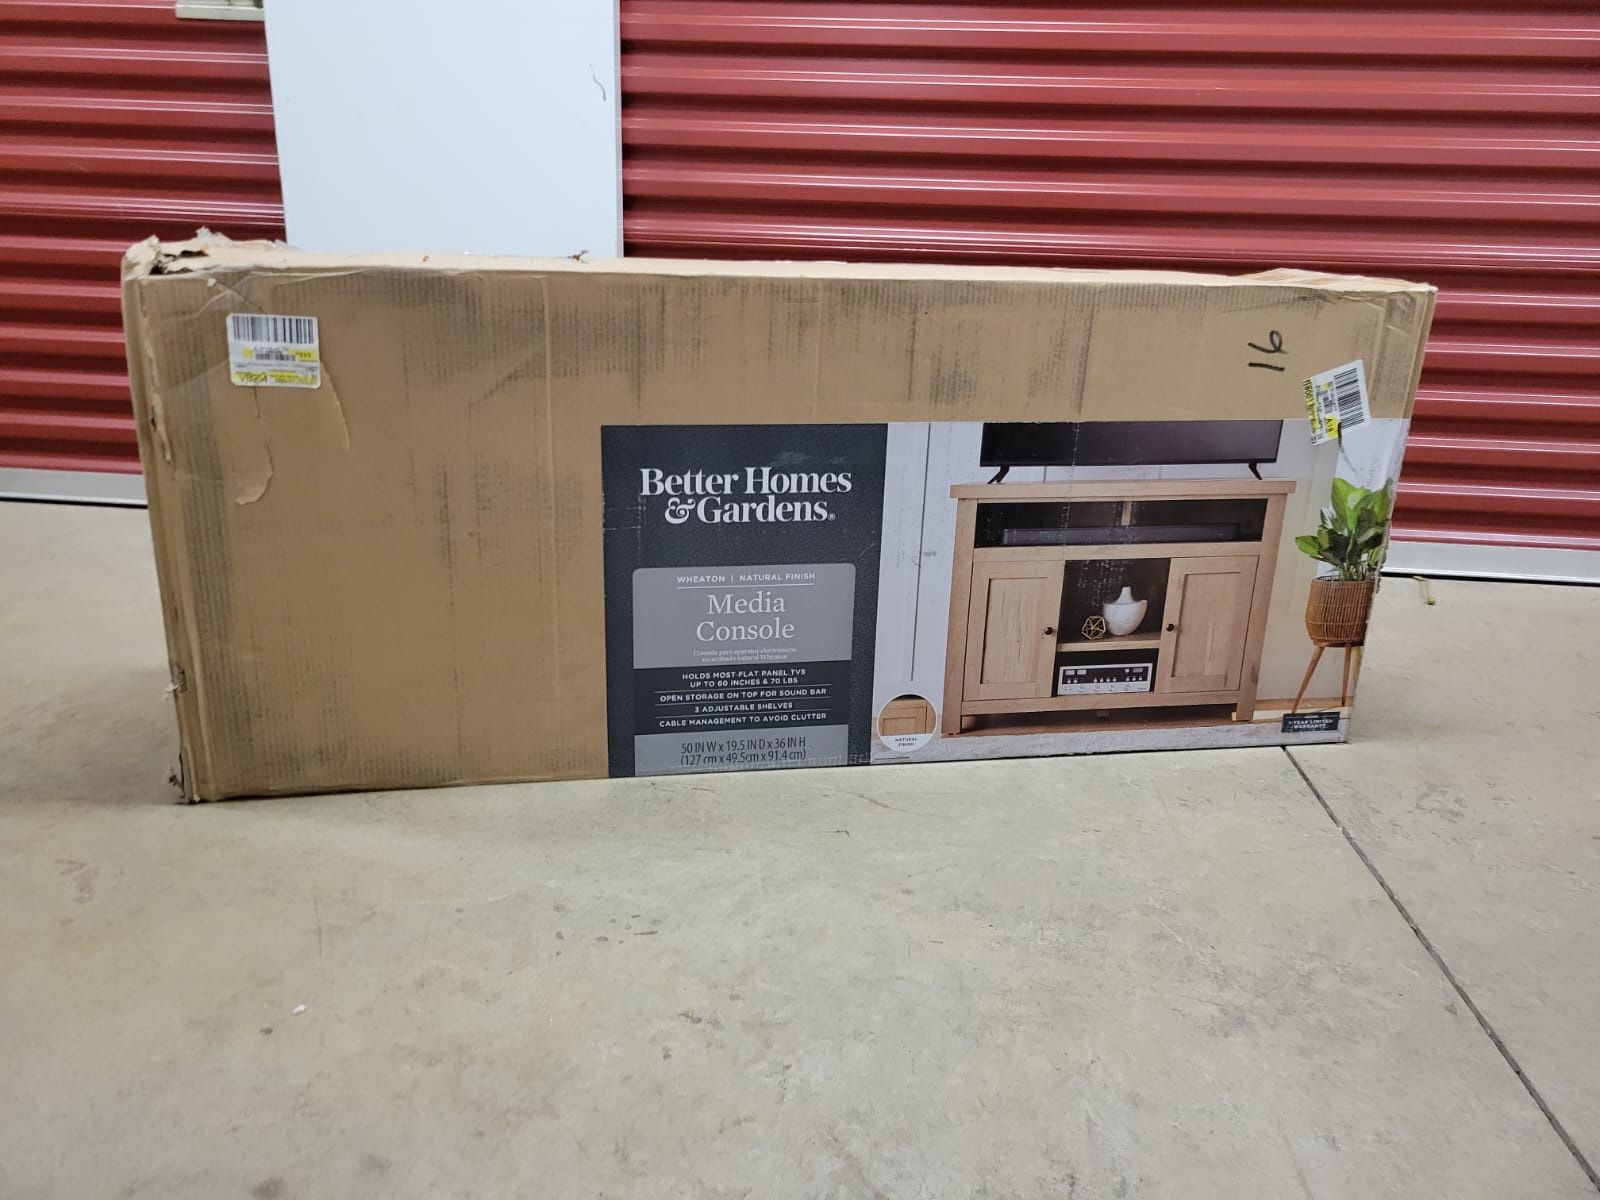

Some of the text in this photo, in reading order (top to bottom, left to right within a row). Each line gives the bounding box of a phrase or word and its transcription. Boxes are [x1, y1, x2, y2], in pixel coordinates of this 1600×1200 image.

[640, 467, 852, 495] Better Homes
[676, 572, 816, 584] WHEATON NATURAL FINISH
[707, 590, 787, 615] Media
[696, 617, 795, 643] Console
[682, 668, 806, 681] HOLDS MOST FLAT PANEL TVS
[730, 679, 761, 687] INCHES
[660, 694, 683, 702] OPEN
[685, 692, 724, 701] STORAGE
[779, 689, 808, 697] SOUND
[702, 703, 755, 713] ADJUSTABLE
[757, 702, 793, 710] SHELVES
[659, 713, 827, 728] CABLE MANAGEMENT TO AVOID CLUTTER
[681, 736, 806, 754] 50 IN W x 19.5 IN D x 36 IN H
[680, 754, 701, 766] (127
[703, 755, 717, 764] cm
[719, 755, 724, 764] x
[761, 752, 766, 761] x
[768, 750, 788, 761] 91.4
[789, 749, 807, 761] cm)
